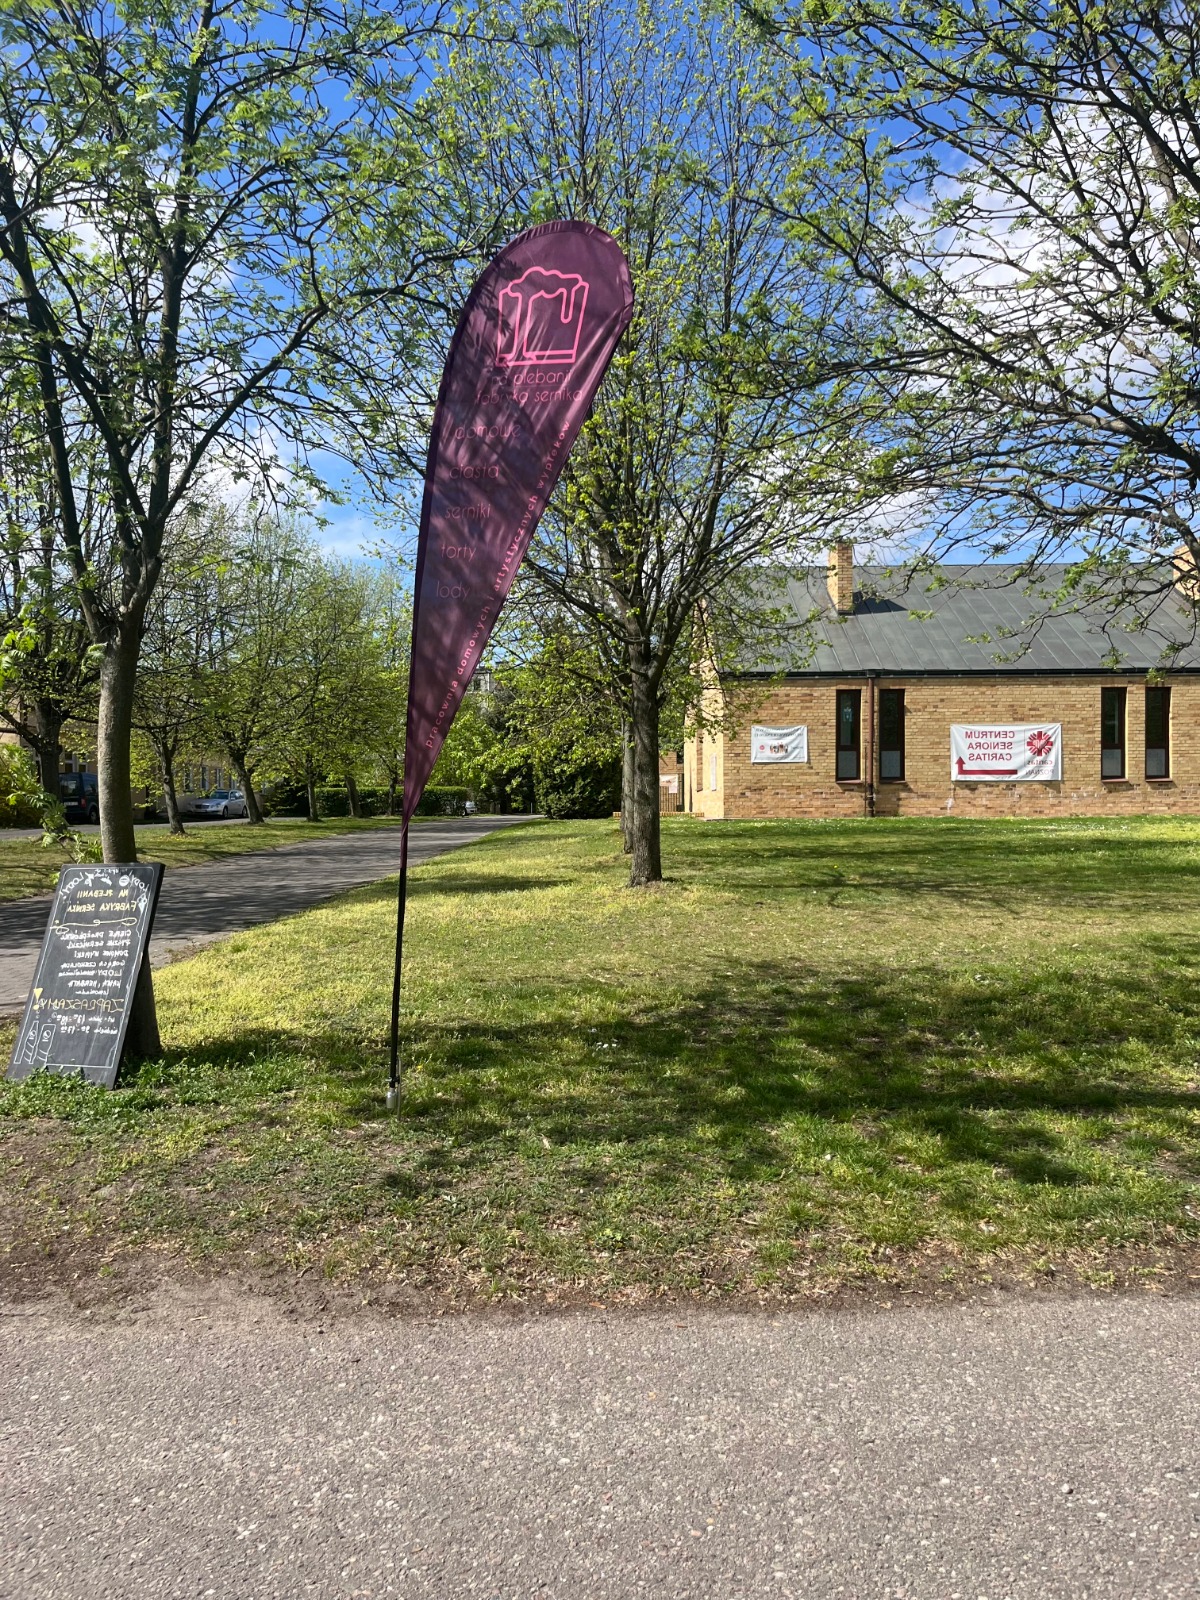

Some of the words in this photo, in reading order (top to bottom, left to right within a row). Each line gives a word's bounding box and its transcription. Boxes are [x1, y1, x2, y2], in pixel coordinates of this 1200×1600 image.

[535, 387, 583, 403] sernika
[454, 423, 521, 440] domowe
[449, 463, 500, 480] ciasta
[444, 503, 491, 520] serniki
[440, 543, 477, 562] torty
[436, 580, 471, 602] lody
[425, 680, 458, 748] pracownia
[457, 604, 491, 675] domowych
[493, 495, 538, 593] artystycznych
